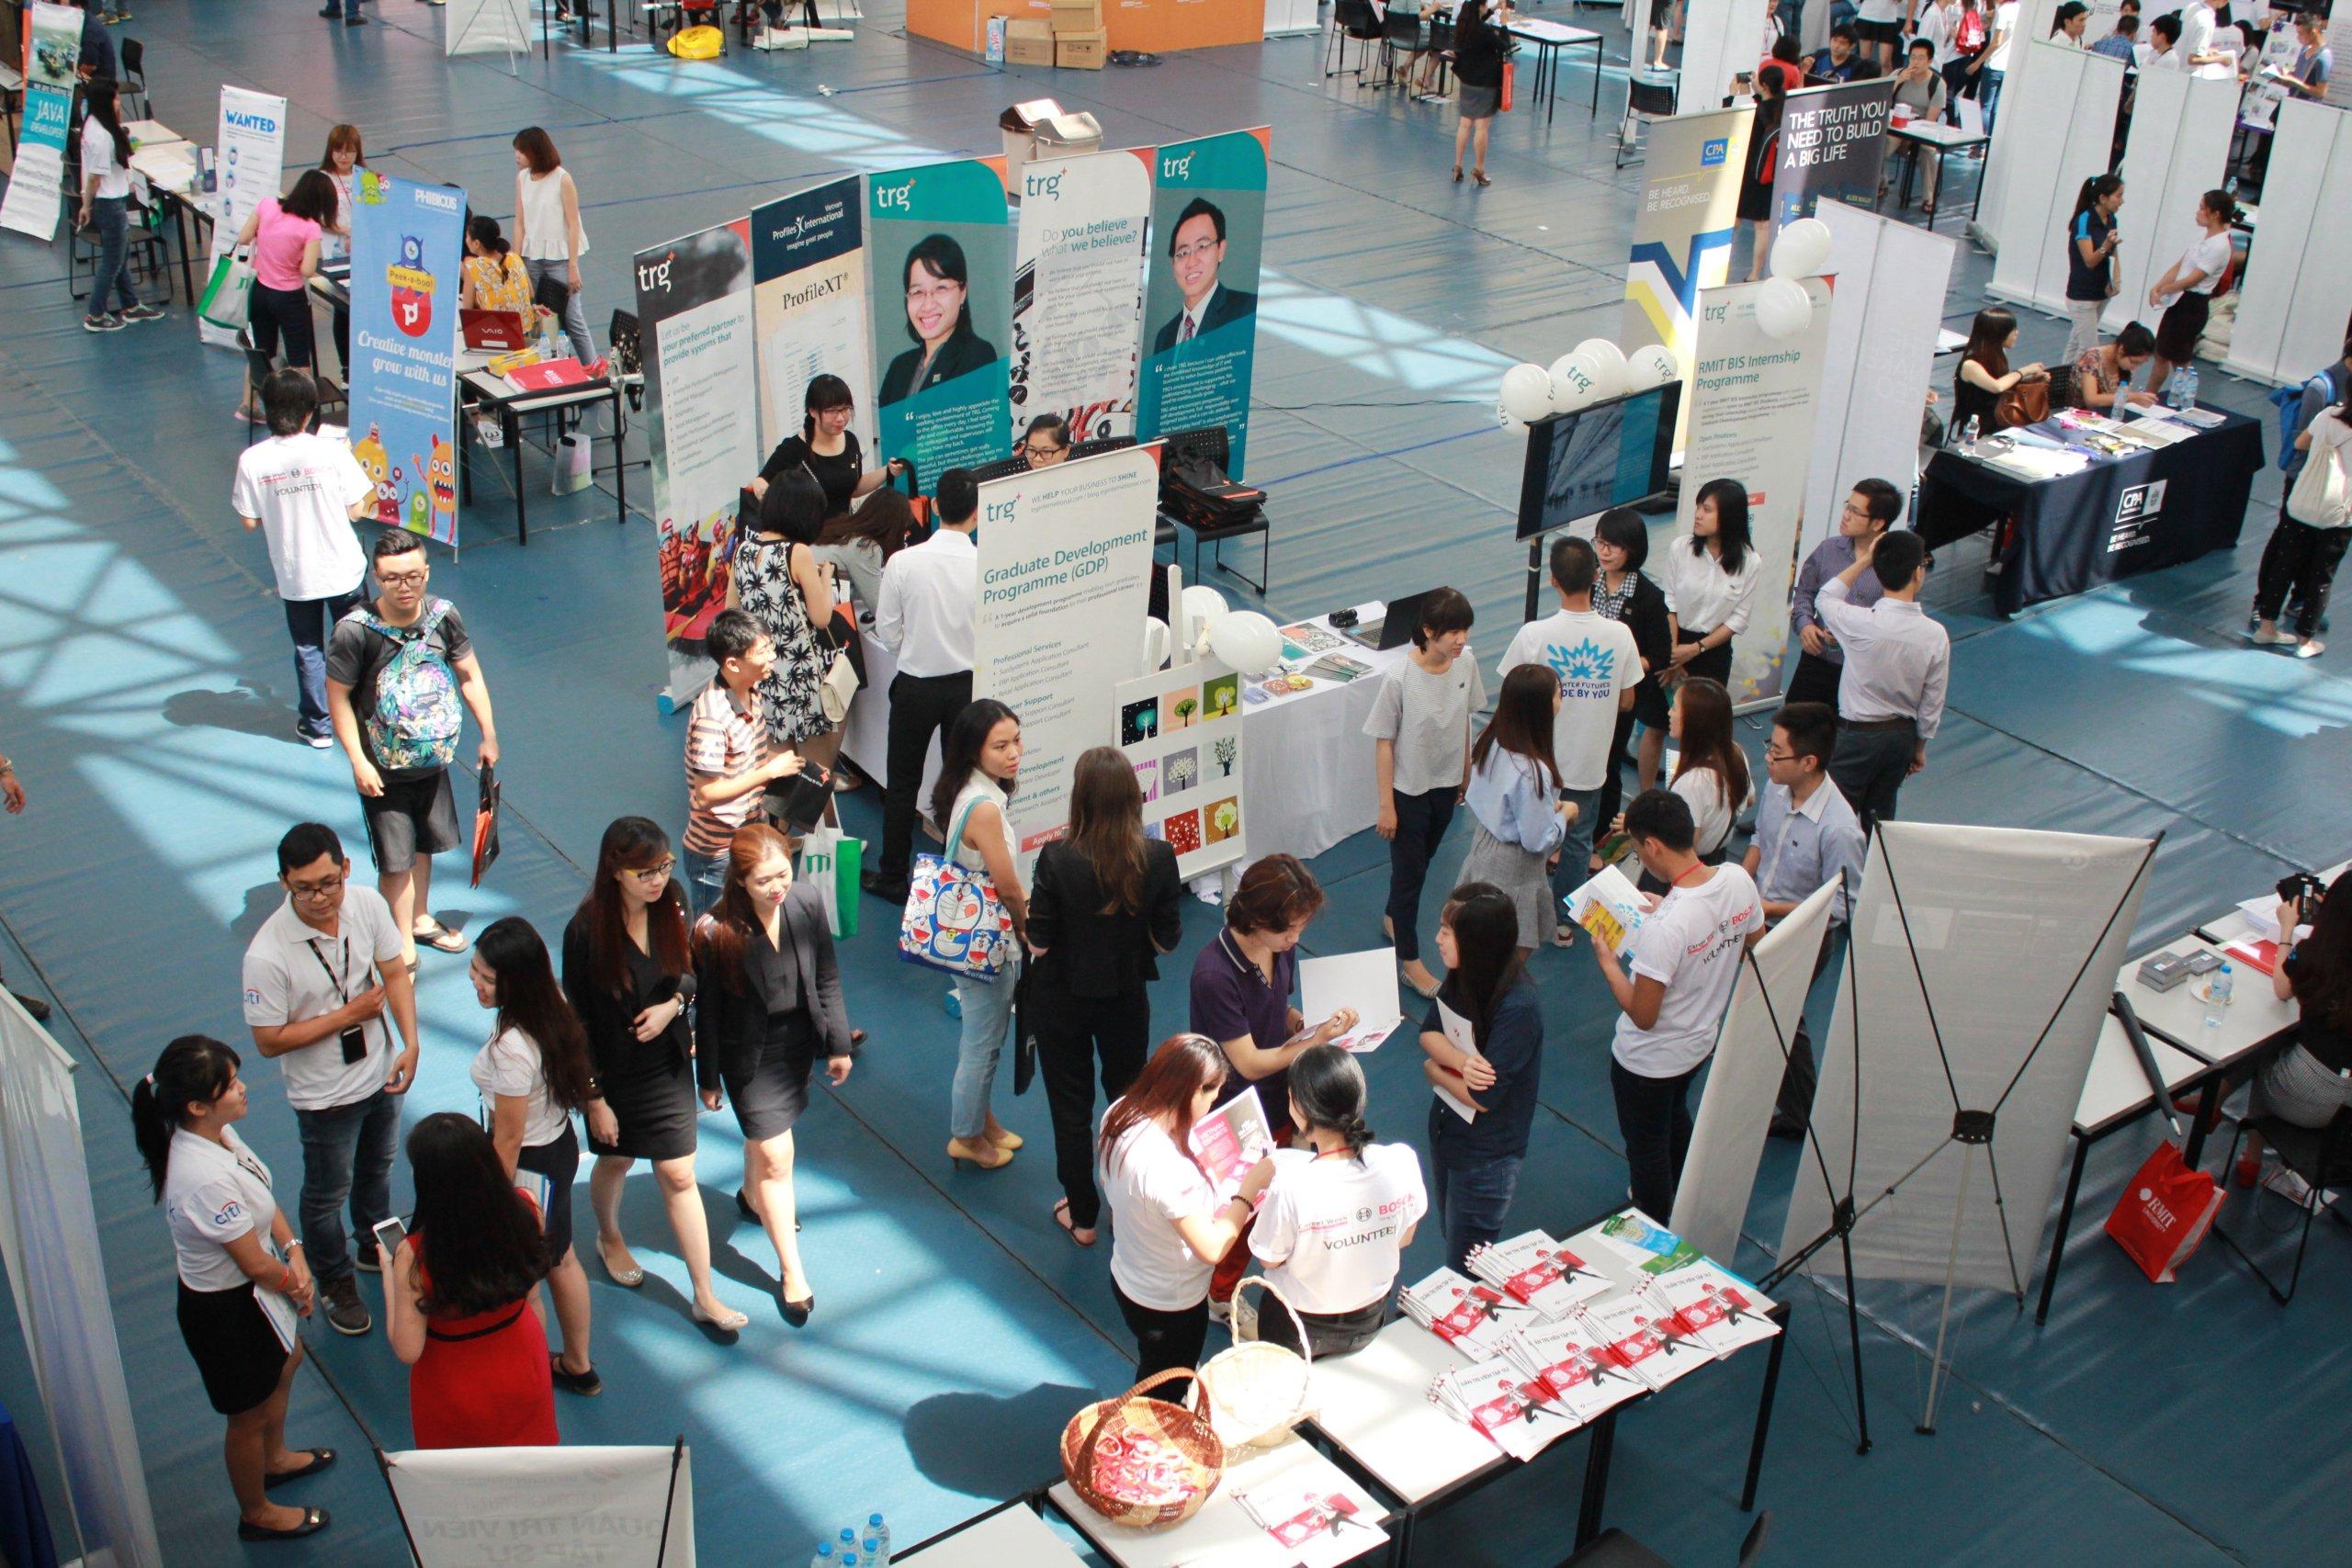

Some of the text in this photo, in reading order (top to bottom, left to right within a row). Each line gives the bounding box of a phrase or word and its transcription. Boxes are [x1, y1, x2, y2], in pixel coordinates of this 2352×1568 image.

[37, 100, 64, 124] JAVA
[225, 109, 276, 133] WANTED
[1789, 101, 1885, 130] THE TRUTH YOU
[1787, 120, 1883, 150] NEED TO BUILD
[1705, 142, 1724, 157] CPA
[1784, 143, 1848, 170] A BIG LIFE
[1164, 156, 1191, 181] trg
[876, 186, 911, 211] trg
[1026, 174, 1062, 201] trg
[1648, 184, 1690, 200] BE HEARD.
[1646, 192, 1711, 213] BE RECOGNISED.
[773, 209, 843, 241] Profiles International
[818, 230, 834, 241] people
[1043, 220, 1127, 243] Do you believe
[1071, 241, 1088, 252] we
[1091, 231, 1137, 248] believe?
[390, 270, 434, 287] Peek-a-boo!
[639, 259, 672, 293] trg
[1705, 304, 1727, 323] trg
[357, 331, 406, 356] Creative
[662, 341, 677, 355] your
[678, 327, 710, 347] preferred
[711, 318, 737, 334] partner
[663, 332, 732, 366] provide systems that
[373, 356, 447, 387] grow with us
[1654, 356, 1673, 382] trg
[1699, 350, 1801, 374] RMIT BIS Internship
[1567, 365, 1592, 394] trg
[1697, 372, 1759, 391] Programme
[1032, 471, 1137, 504] WE HELP YOUR BUSINESS TO SHINE
[2123, 491, 2143, 508] CPA
[987, 501, 1017, 523] trg
[984, 529, 1148, 584] Graduate Development
[983, 557, 1109, 604] Programme (GDP)
[1001, 609, 1017, 620] 1-year
[1018, 599, 1052, 615] development
[1053, 591, 1082, 608] programme
[1001, 615, 1021, 628] acquire
[1025, 611, 1038, 620] solid
[1039, 604, 1069, 615] foundation
[1087, 586, 1117, 603] professional
[1118, 583, 1135, 593] career
[993, 640, 1061, 665] Professional Services
[1031, 651, 1061, 668] Application
[1062, 641, 1090, 659] Consultant
[1010, 669, 1040, 684] Application
[1041, 660, 1069, 674] Consultant
[1013, 678, 1045, 694] Application
[1045, 670, 1073, 683] Consultant
[1023, 694, 1053, 706] Support
[1048, 696, 1075, 711] Consultant
[1562, 689, 1610, 698] DE BY YOU
[1044, 708, 1071, 725] Consultant
[1019, 756, 1065, 776] Development
[1039, 784, 1060, 797] others
[1033, 833, 1053, 847] Apply
[215, 1204, 241, 1224] citi
[1378, 1193, 1415, 1215] BOSCH
[2147, 1197, 2177, 1228] RMIT
